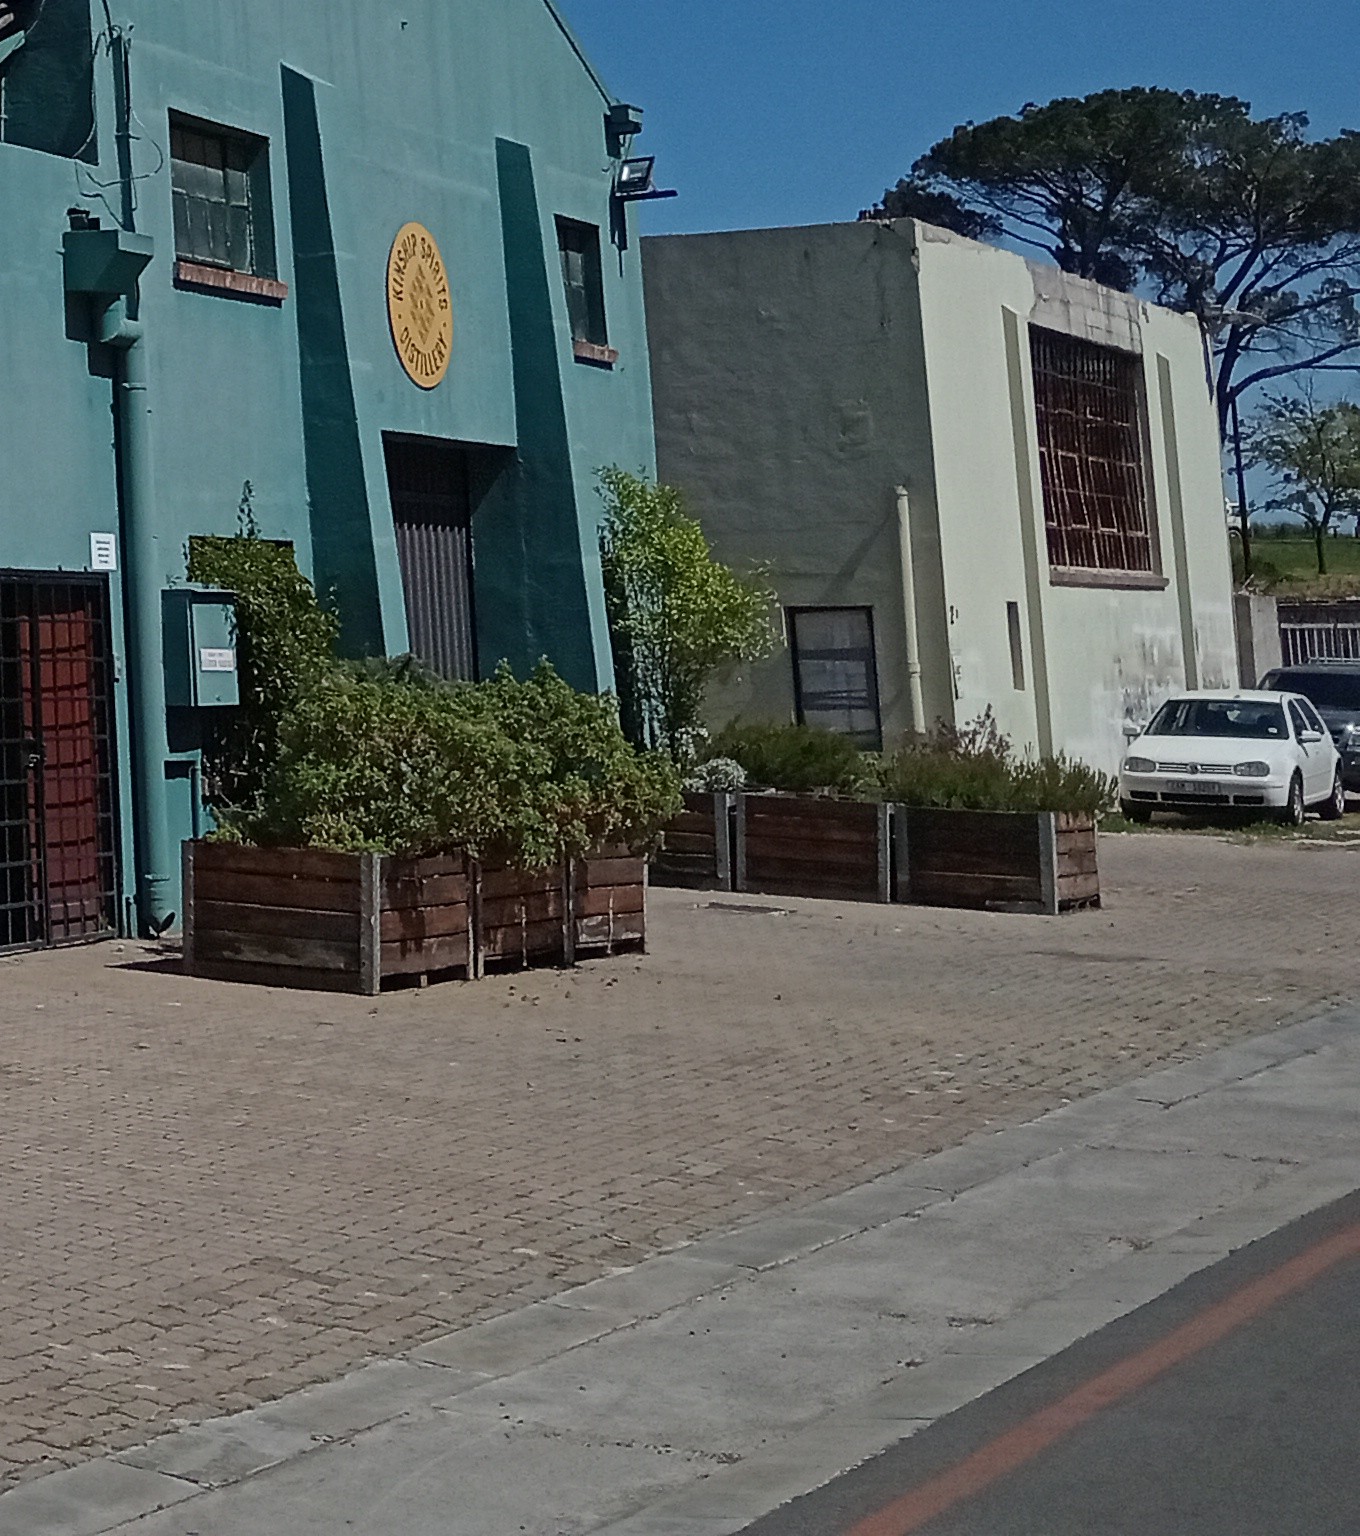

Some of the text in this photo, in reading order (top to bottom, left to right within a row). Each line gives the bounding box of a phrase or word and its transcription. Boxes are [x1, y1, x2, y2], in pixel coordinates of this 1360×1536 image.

[392, 233, 448, 311] KINSHIP SPIRITS
[399, 326, 447, 377] DISTILLERY
